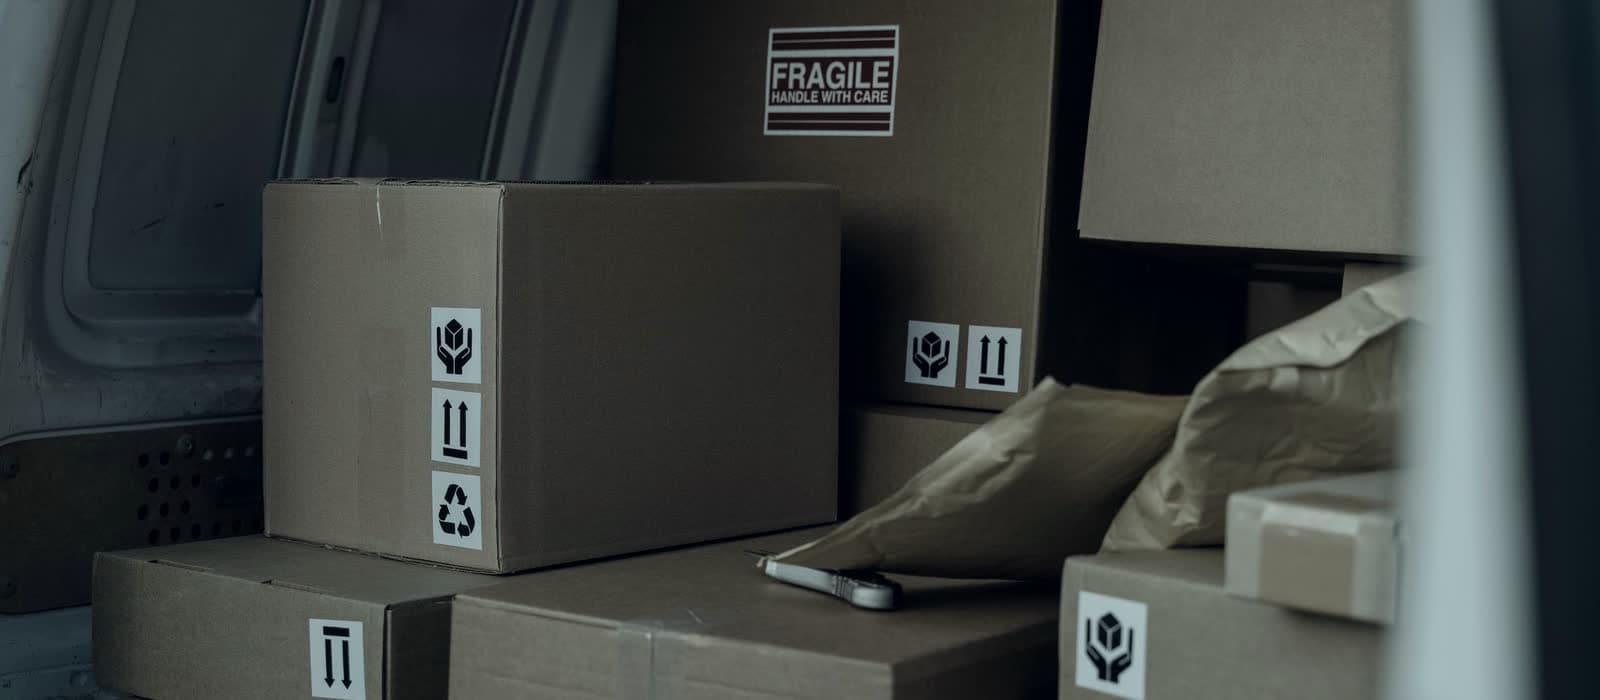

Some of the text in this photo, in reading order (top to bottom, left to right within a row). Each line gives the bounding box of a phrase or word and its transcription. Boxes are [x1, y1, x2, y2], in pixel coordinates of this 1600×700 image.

[772, 61, 890, 89] FRAGILE
[771, 90, 889, 104] HANDLE WITH CARE
